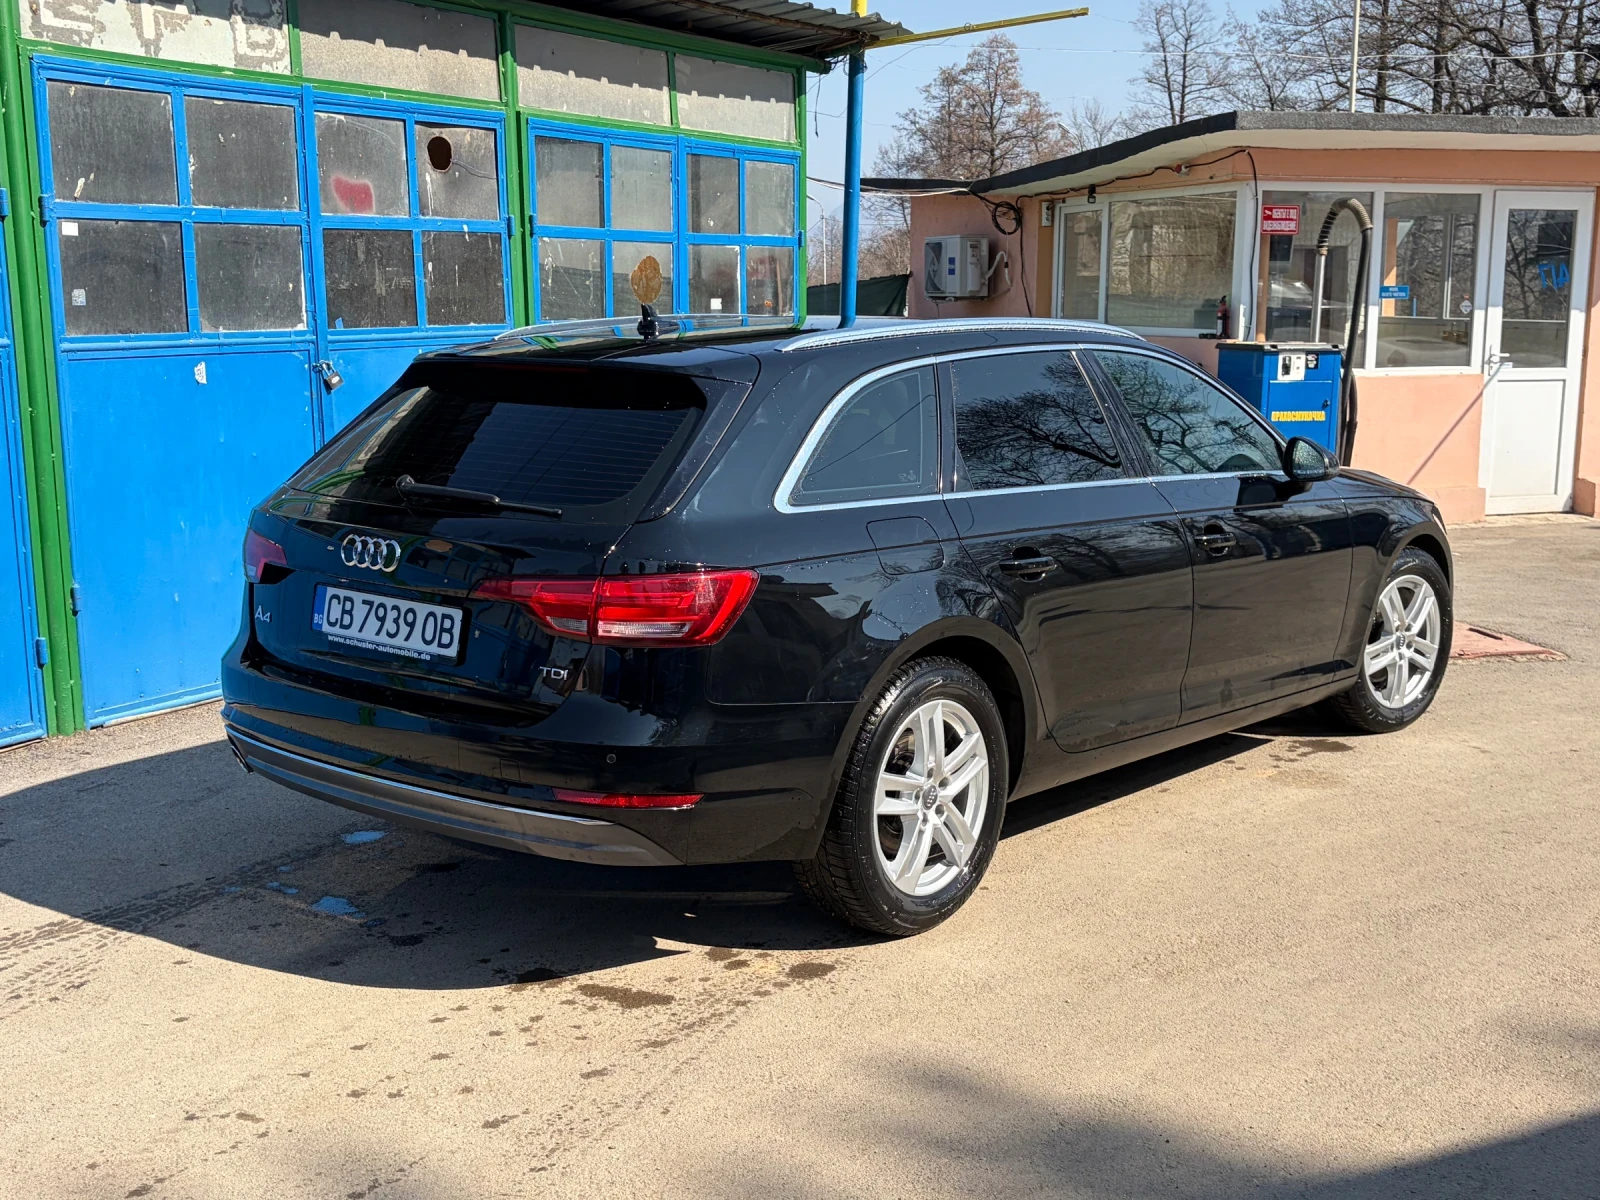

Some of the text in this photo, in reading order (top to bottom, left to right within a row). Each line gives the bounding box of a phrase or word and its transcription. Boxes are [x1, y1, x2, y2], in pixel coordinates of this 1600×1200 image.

[255, 605, 271, 623] A4
[314, 613, 323, 624] BG
[357, 599, 417, 642] 7939
[327, 634, 431, 661] www.schuster-automobile.de
[539, 665, 569, 681] TDI
